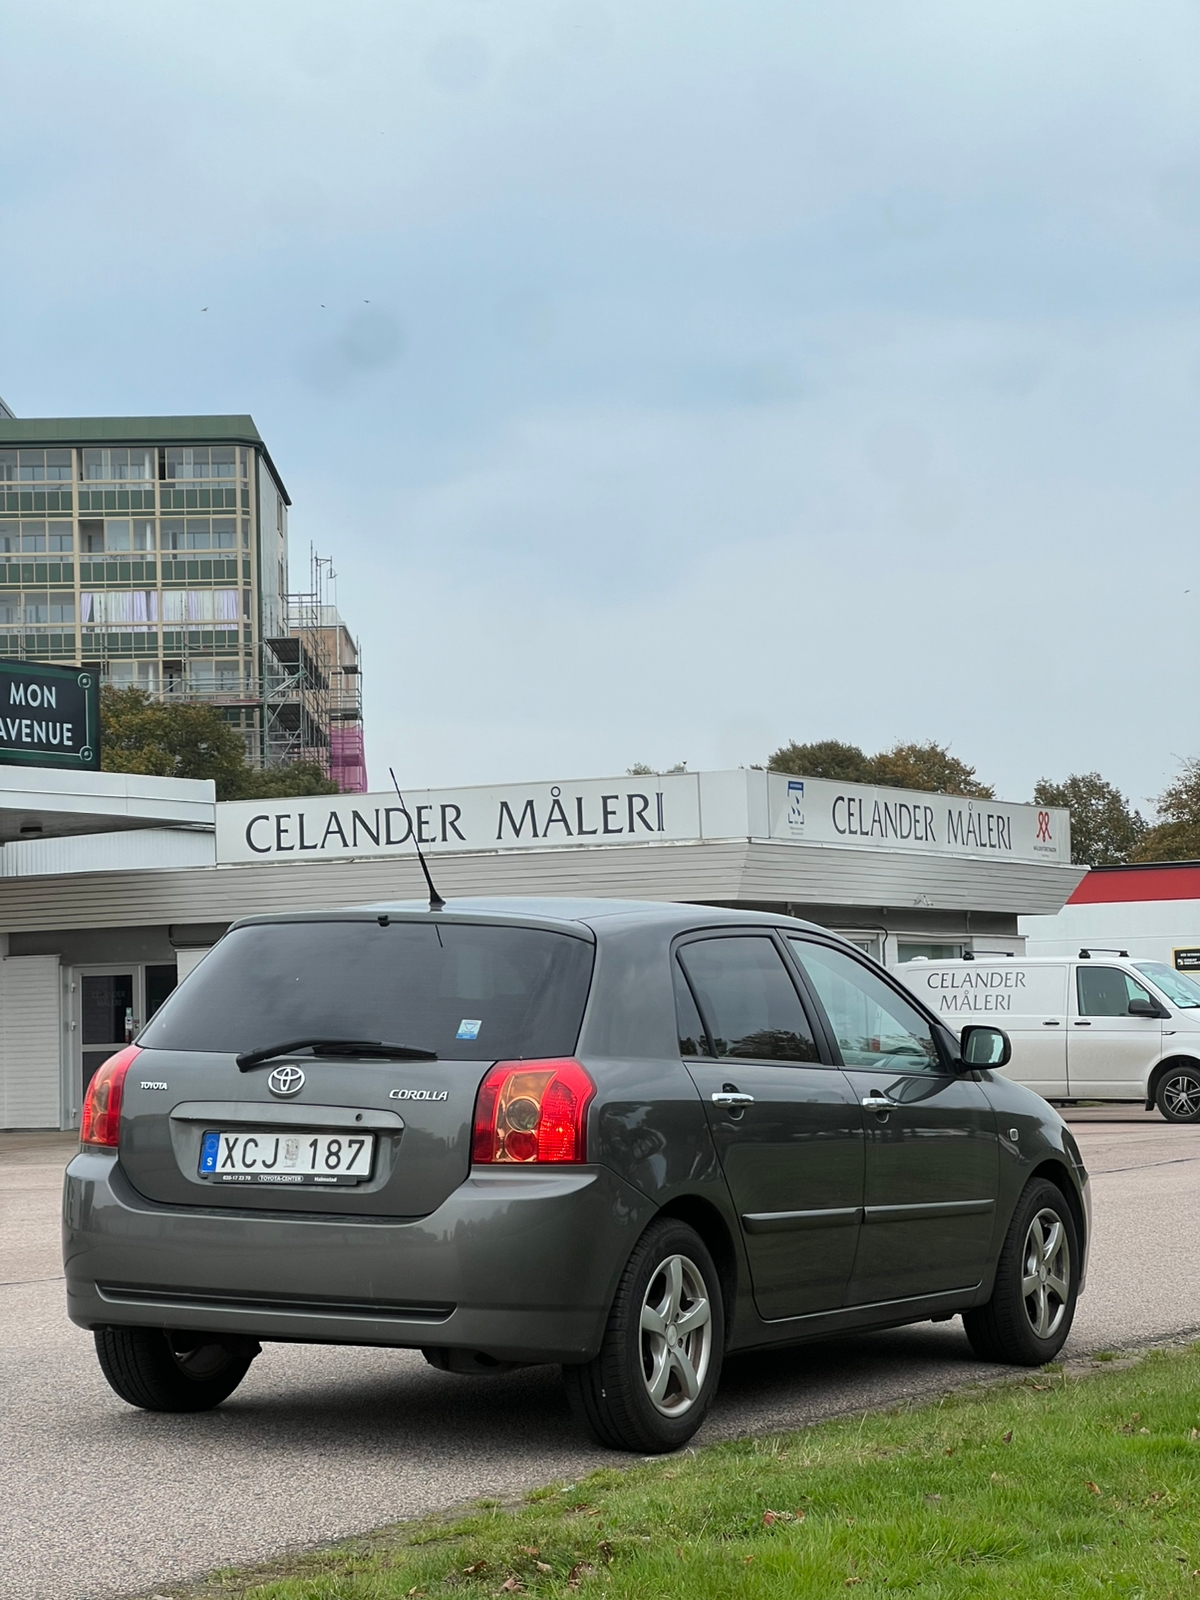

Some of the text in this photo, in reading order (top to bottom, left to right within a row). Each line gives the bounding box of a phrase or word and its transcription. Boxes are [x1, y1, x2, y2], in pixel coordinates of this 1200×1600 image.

[9, 681, 57, 709] MON
[245, 786, 665, 853] CELANDER MÅLERI
[832, 795, 1013, 850] CELANDER MÅLERI
[927, 971, 1027, 989] CELANDER
[939, 989, 1012, 1011] MÅLERI
[140, 1081, 168, 1090] TOYOTA
[389, 1089, 449, 1101] COROLLA
[206, 1137, 366, 1171] S XCJ 187
